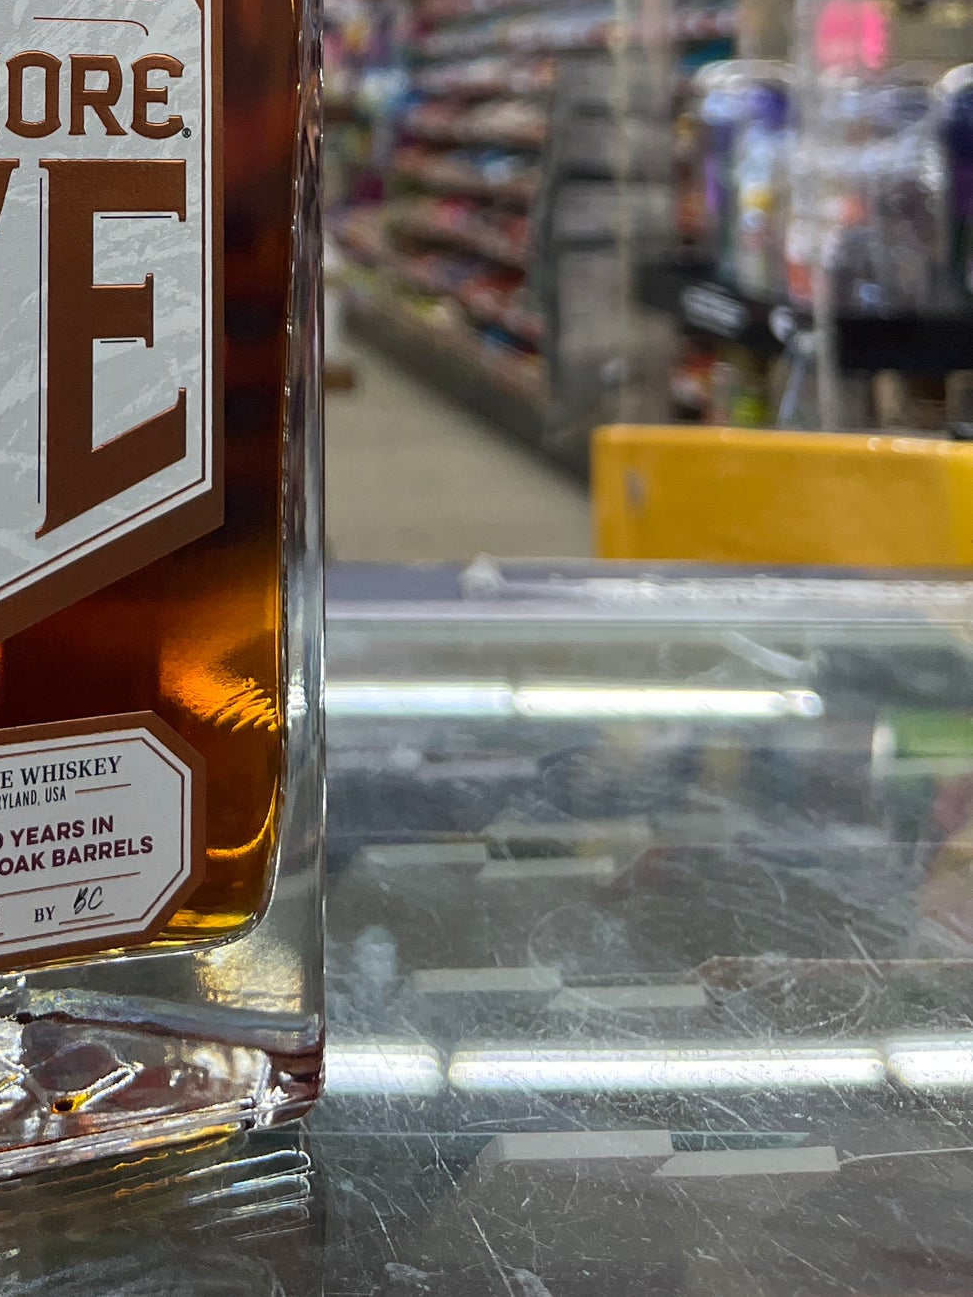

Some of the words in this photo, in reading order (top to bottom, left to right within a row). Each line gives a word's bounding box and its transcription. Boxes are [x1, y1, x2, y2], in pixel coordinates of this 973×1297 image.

[20, 755, 123, 786] WHISKEY
[45, 785, 67, 803] USA
[10, 819, 85, 848] YEARS
[91, 814, 114, 836] IN
[51, 834, 154, 868] BARRELS
[33, 905, 56, 923] BY
